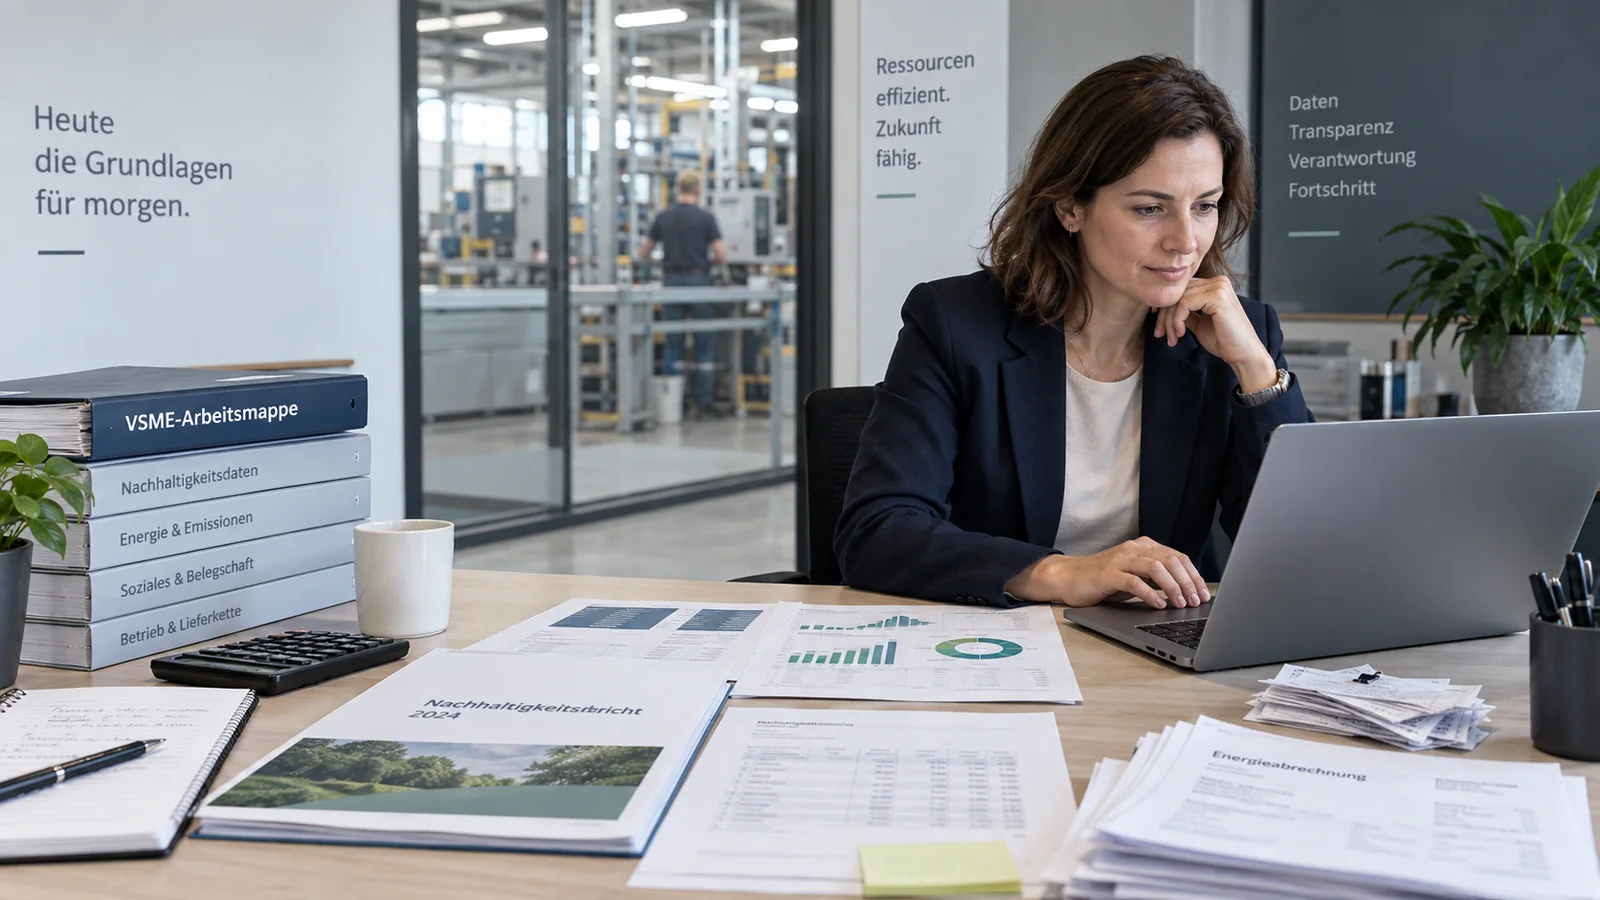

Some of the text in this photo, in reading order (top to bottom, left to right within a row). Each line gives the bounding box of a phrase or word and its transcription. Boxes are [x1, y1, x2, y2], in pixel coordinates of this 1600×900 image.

[876, 54, 975, 75] Ressourcen
[876, 86, 950, 107] effizient.
[1289, 95, 1339, 112] Daten
[34, 104, 115, 134] Heute
[876, 116, 942, 138] Zukunft
[1289, 121, 1394, 141] Transparenz
[34, 147, 233, 185] die Grundlagen
[876, 149, 921, 170] fähig.
[1288, 150, 1417, 169] Verantwortung
[1289, 180, 1377, 198] Fortschritt
[35, 189, 190, 223] für morgen.
[125, 402, 299, 432] VSME-Arbeitsmappe
[121, 465, 258, 495] Nachhaltigkeitsdaten
[120, 513, 253, 547] Energie & Emissionen
[120, 557, 254, 598] Soziales & Belegschaft
[120, 605, 242, 646] Betrieb & Lieferkette
[408, 710, 462, 720] 2024
[1212, 750, 1367, 782] Energieabrechnung
